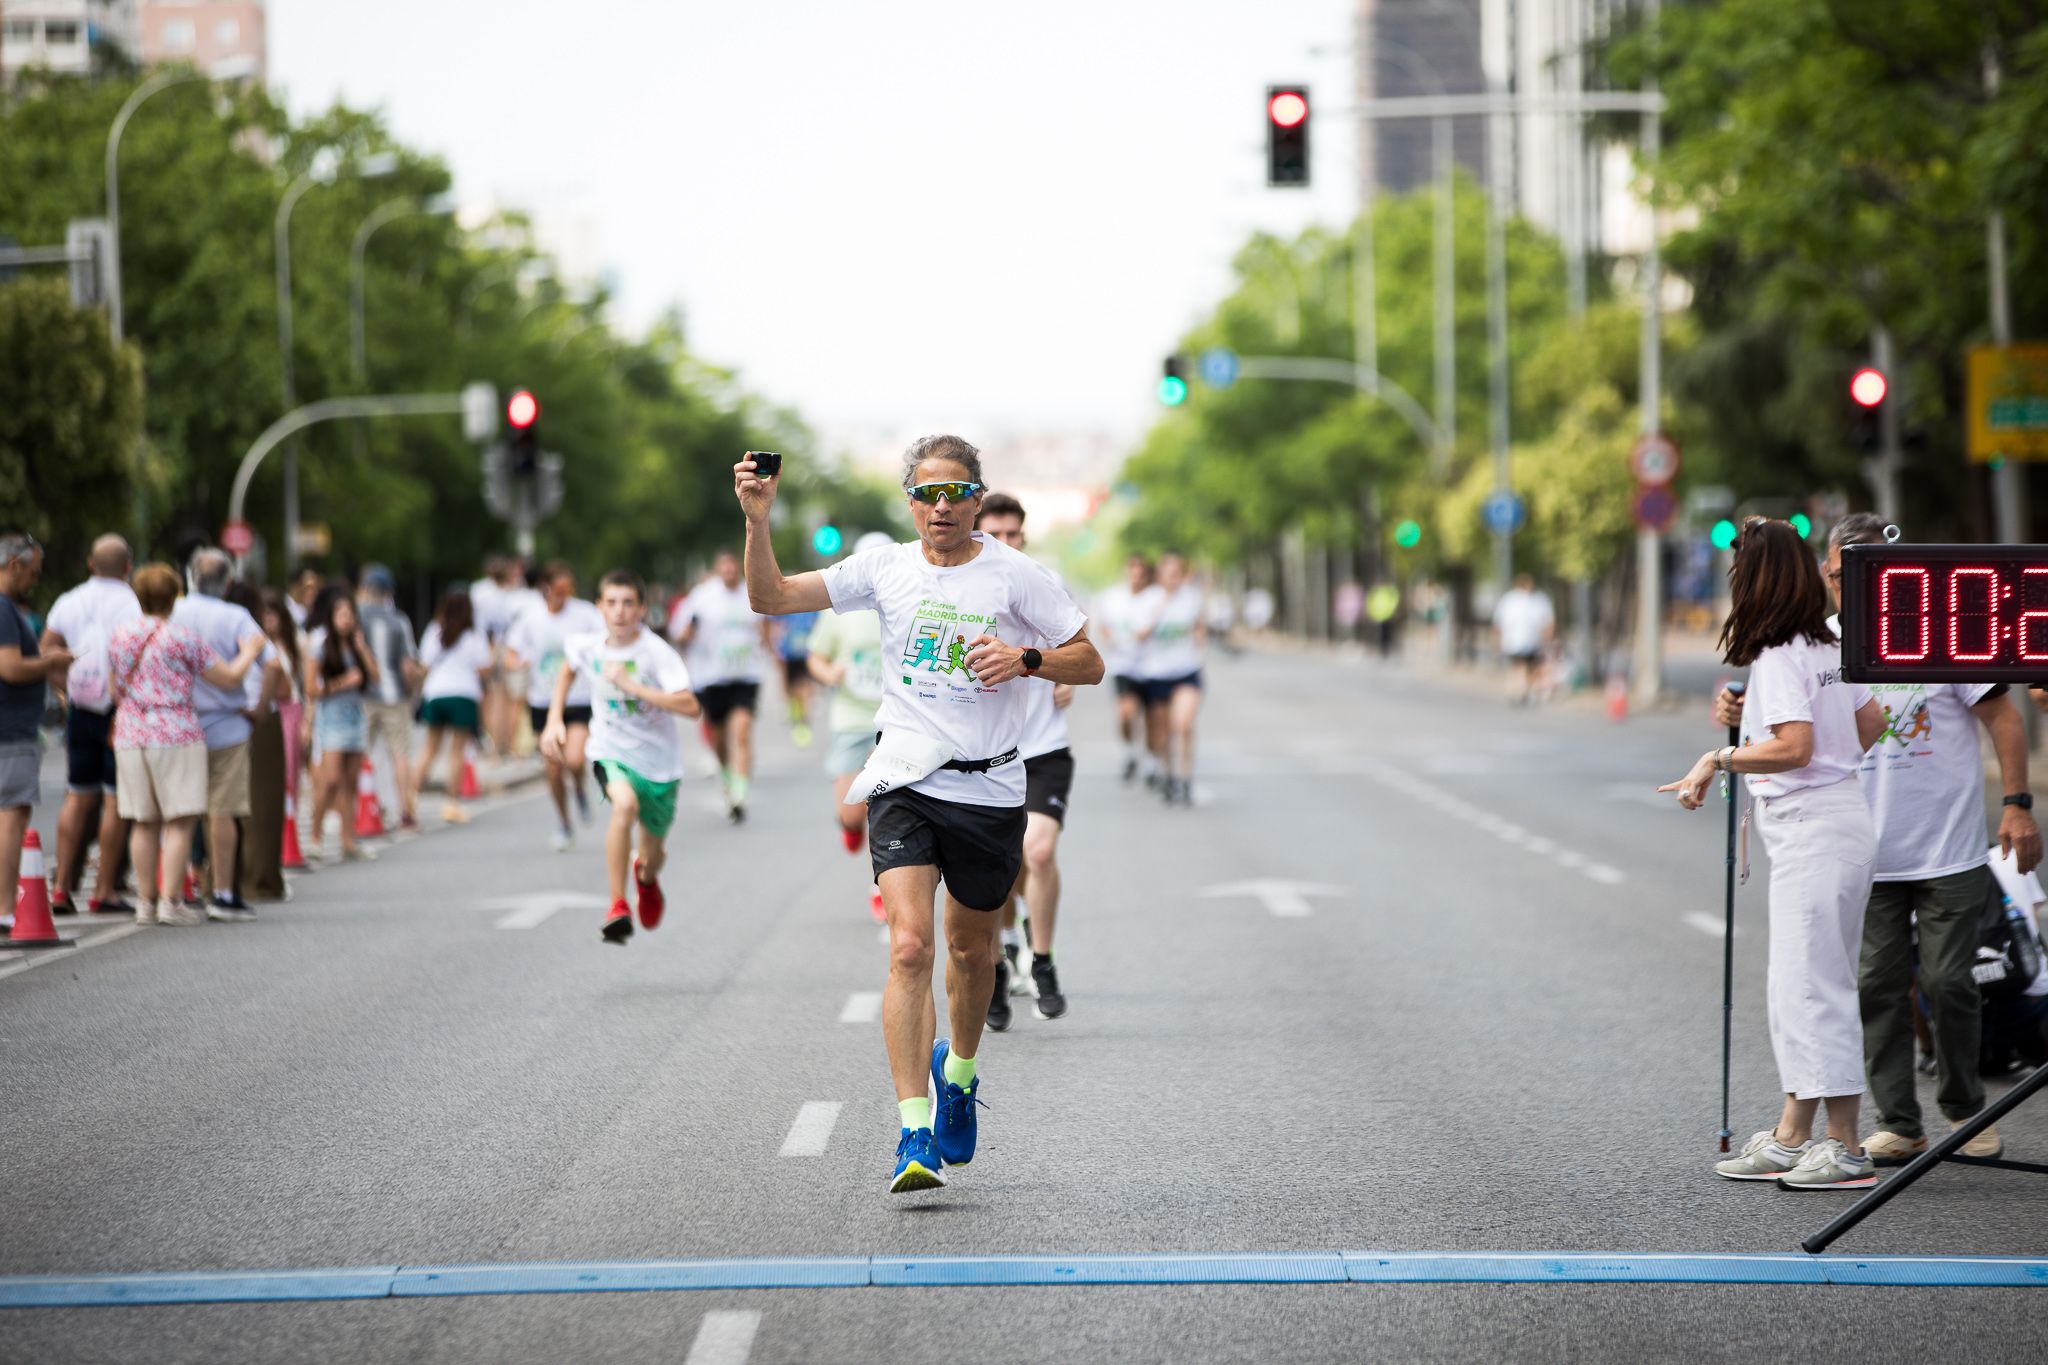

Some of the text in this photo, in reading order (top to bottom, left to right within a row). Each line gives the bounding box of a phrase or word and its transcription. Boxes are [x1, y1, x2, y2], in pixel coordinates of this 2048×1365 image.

[916, 608, 997, 625] MADRID CON LA
